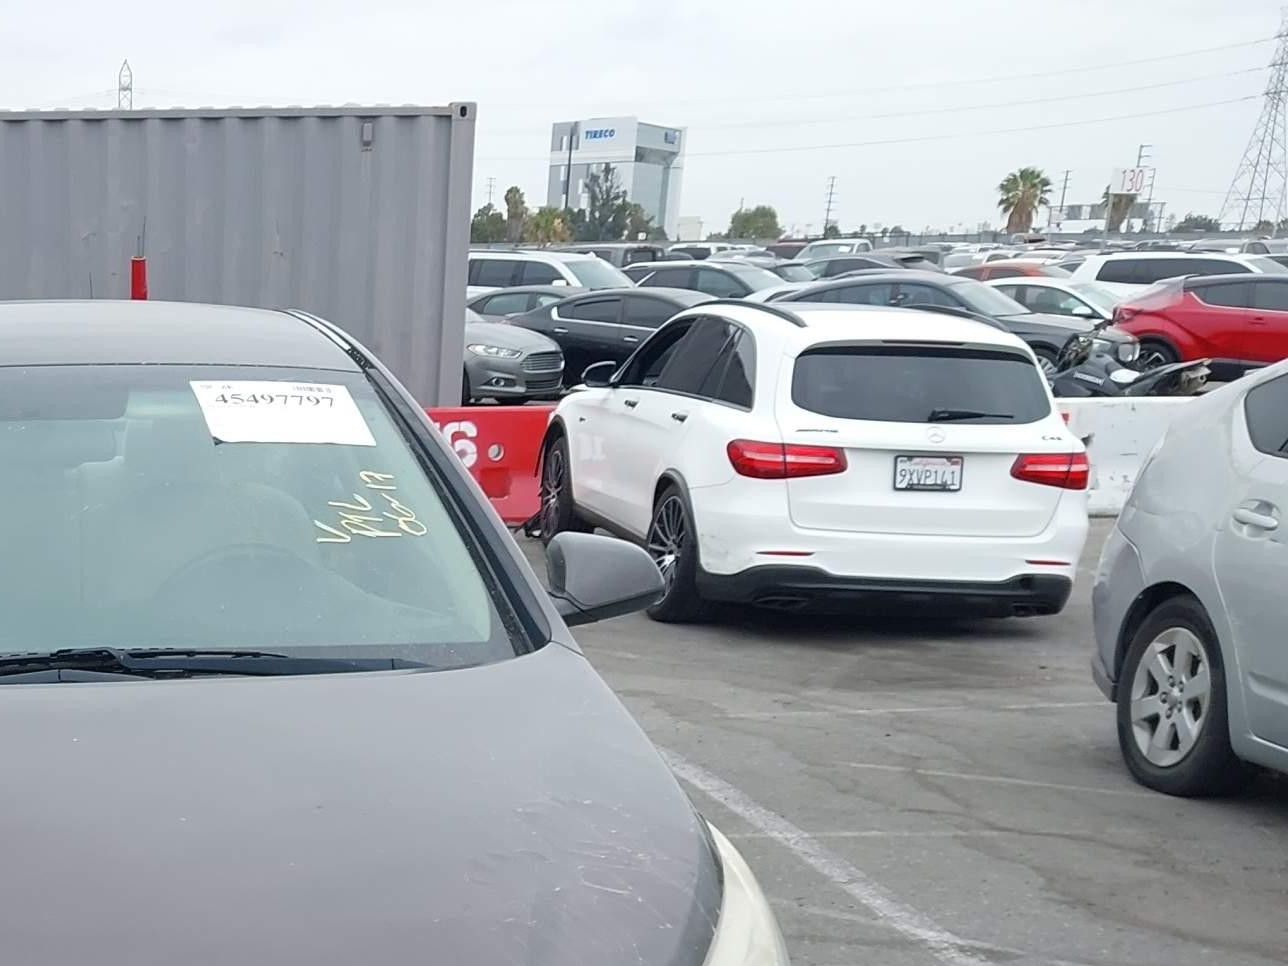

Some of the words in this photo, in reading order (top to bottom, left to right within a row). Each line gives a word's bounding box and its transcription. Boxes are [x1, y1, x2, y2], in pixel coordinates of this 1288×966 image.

[585, 128, 616, 140] TIRECO
[1121, 169, 1144, 192] 130
[215, 393, 335, 408] 45497797
[433, 420, 478, 470] 6
